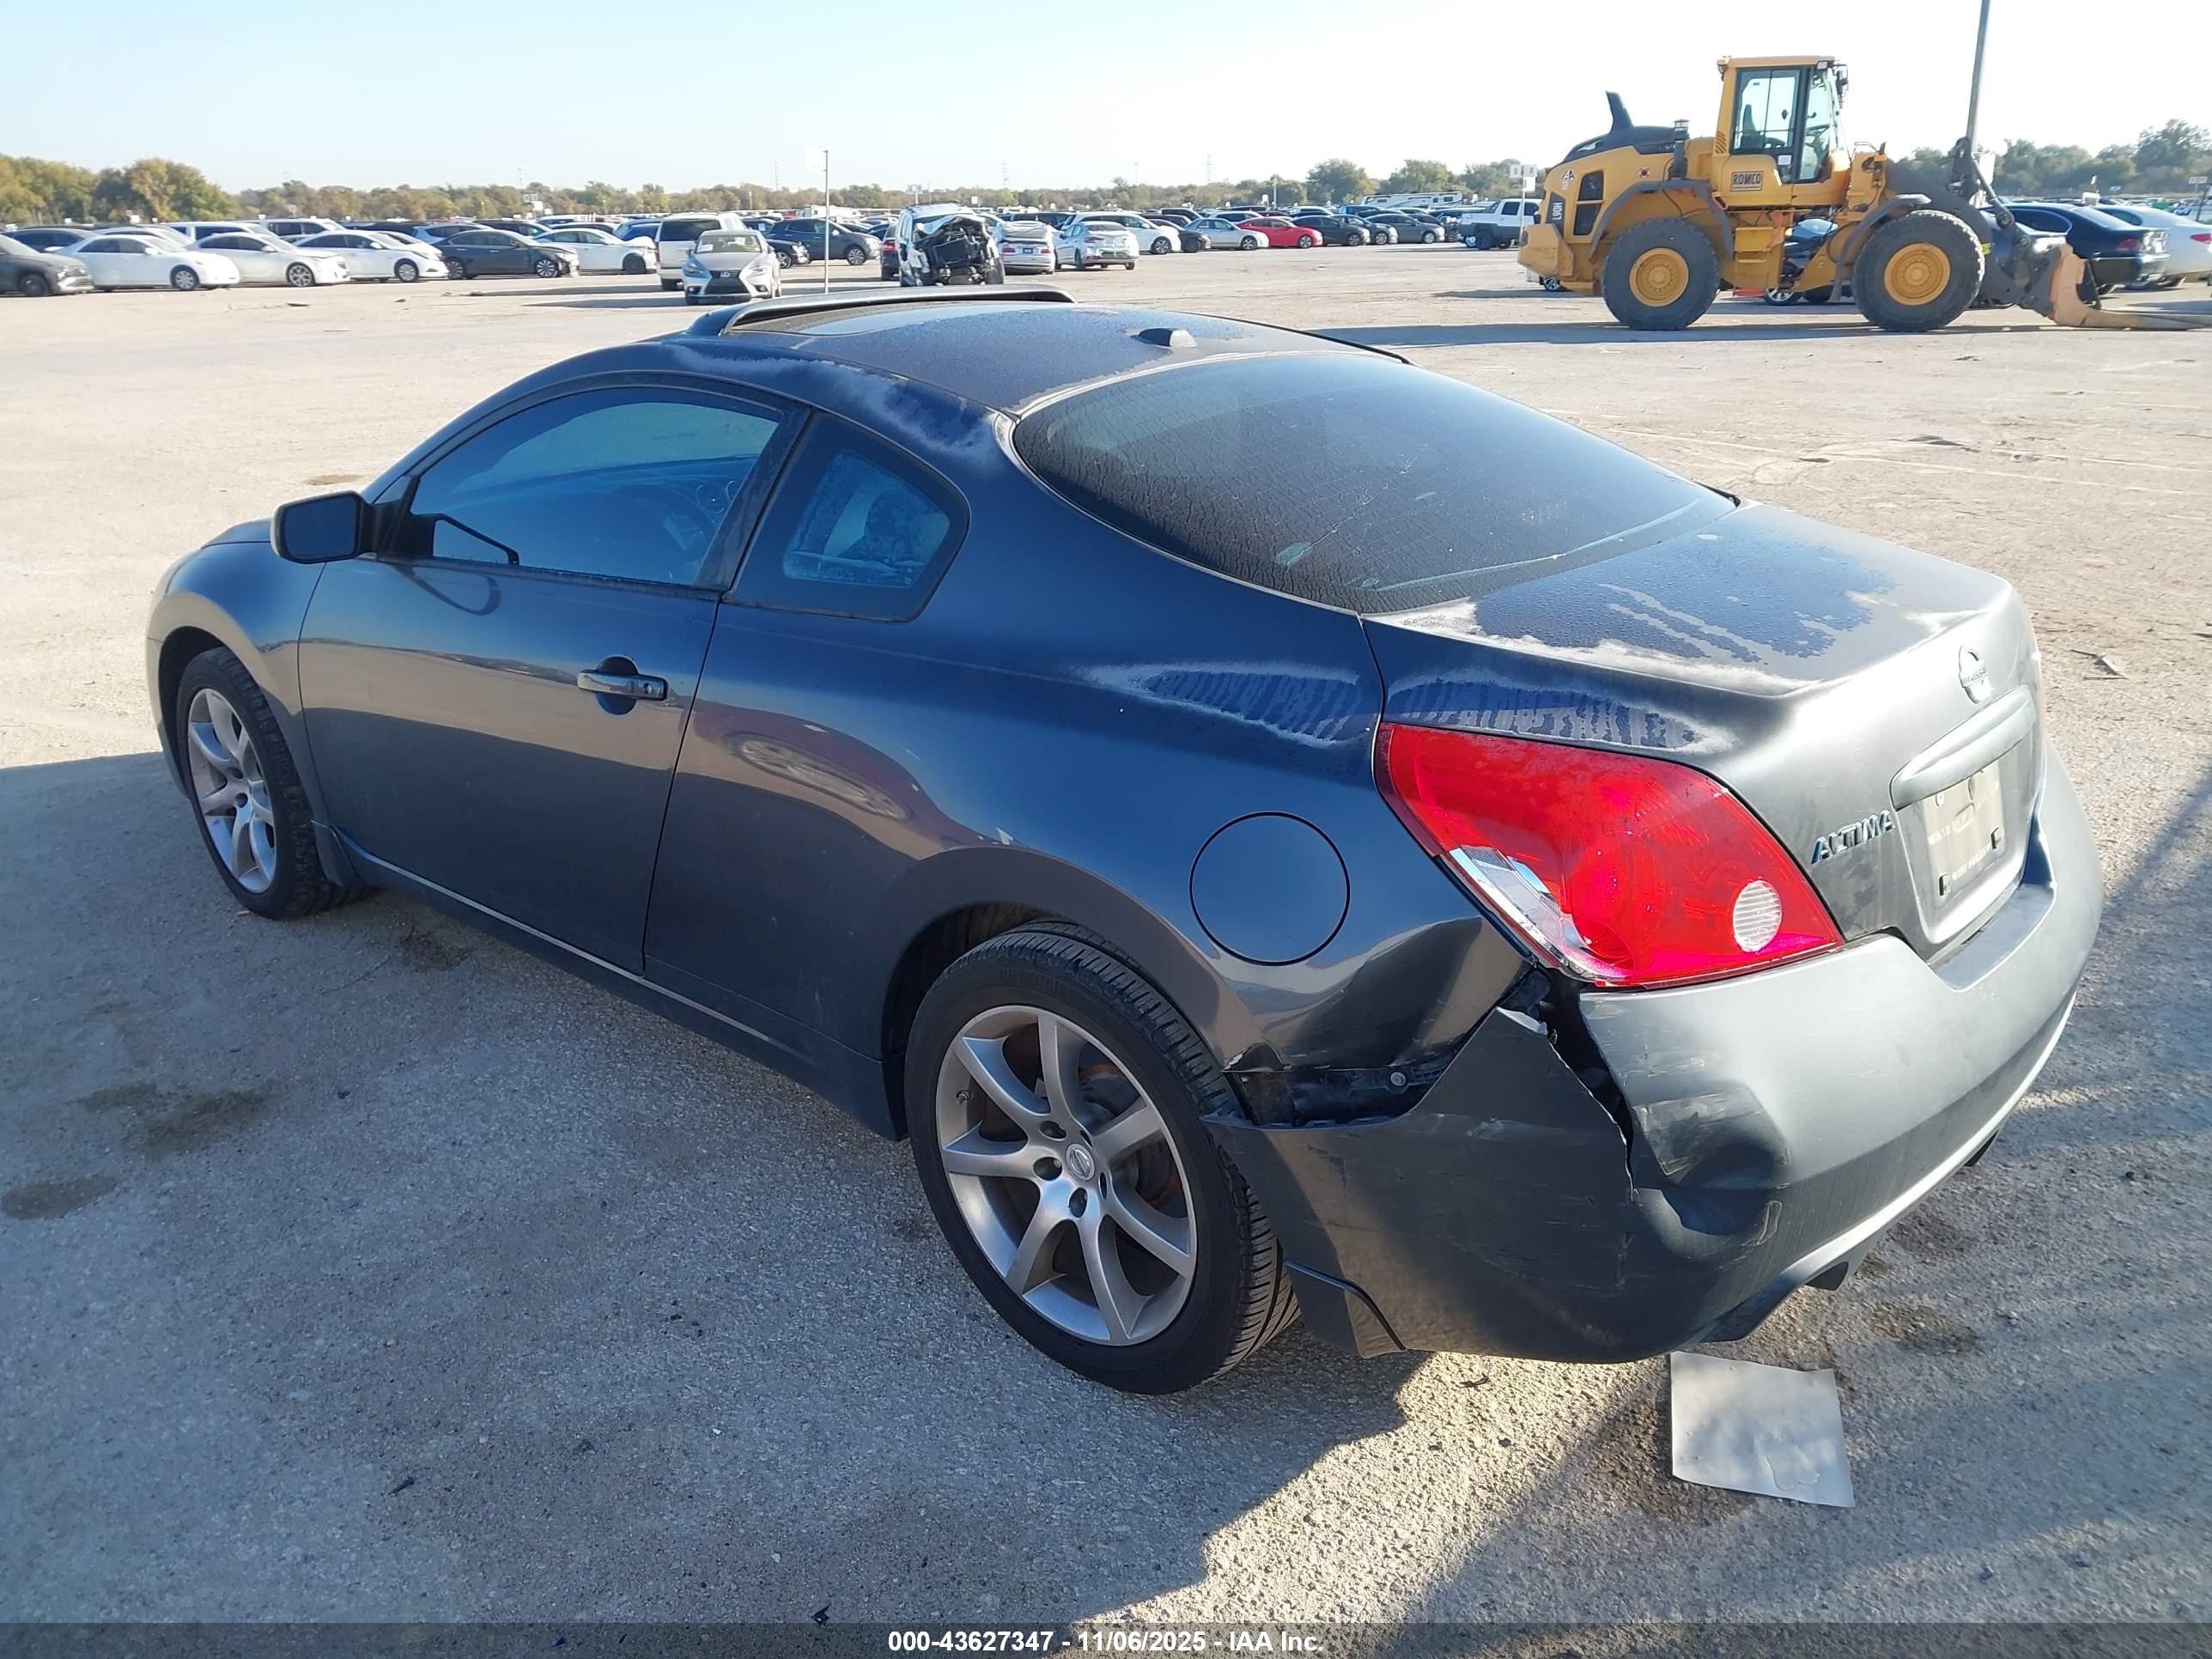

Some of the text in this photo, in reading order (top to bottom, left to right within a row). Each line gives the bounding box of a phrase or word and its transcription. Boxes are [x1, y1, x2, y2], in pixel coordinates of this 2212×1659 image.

[1733, 173, 1761, 185] ROMCO
[1553, 202, 1563, 220] L90H
[1810, 810, 1896, 865] ALTIMA
